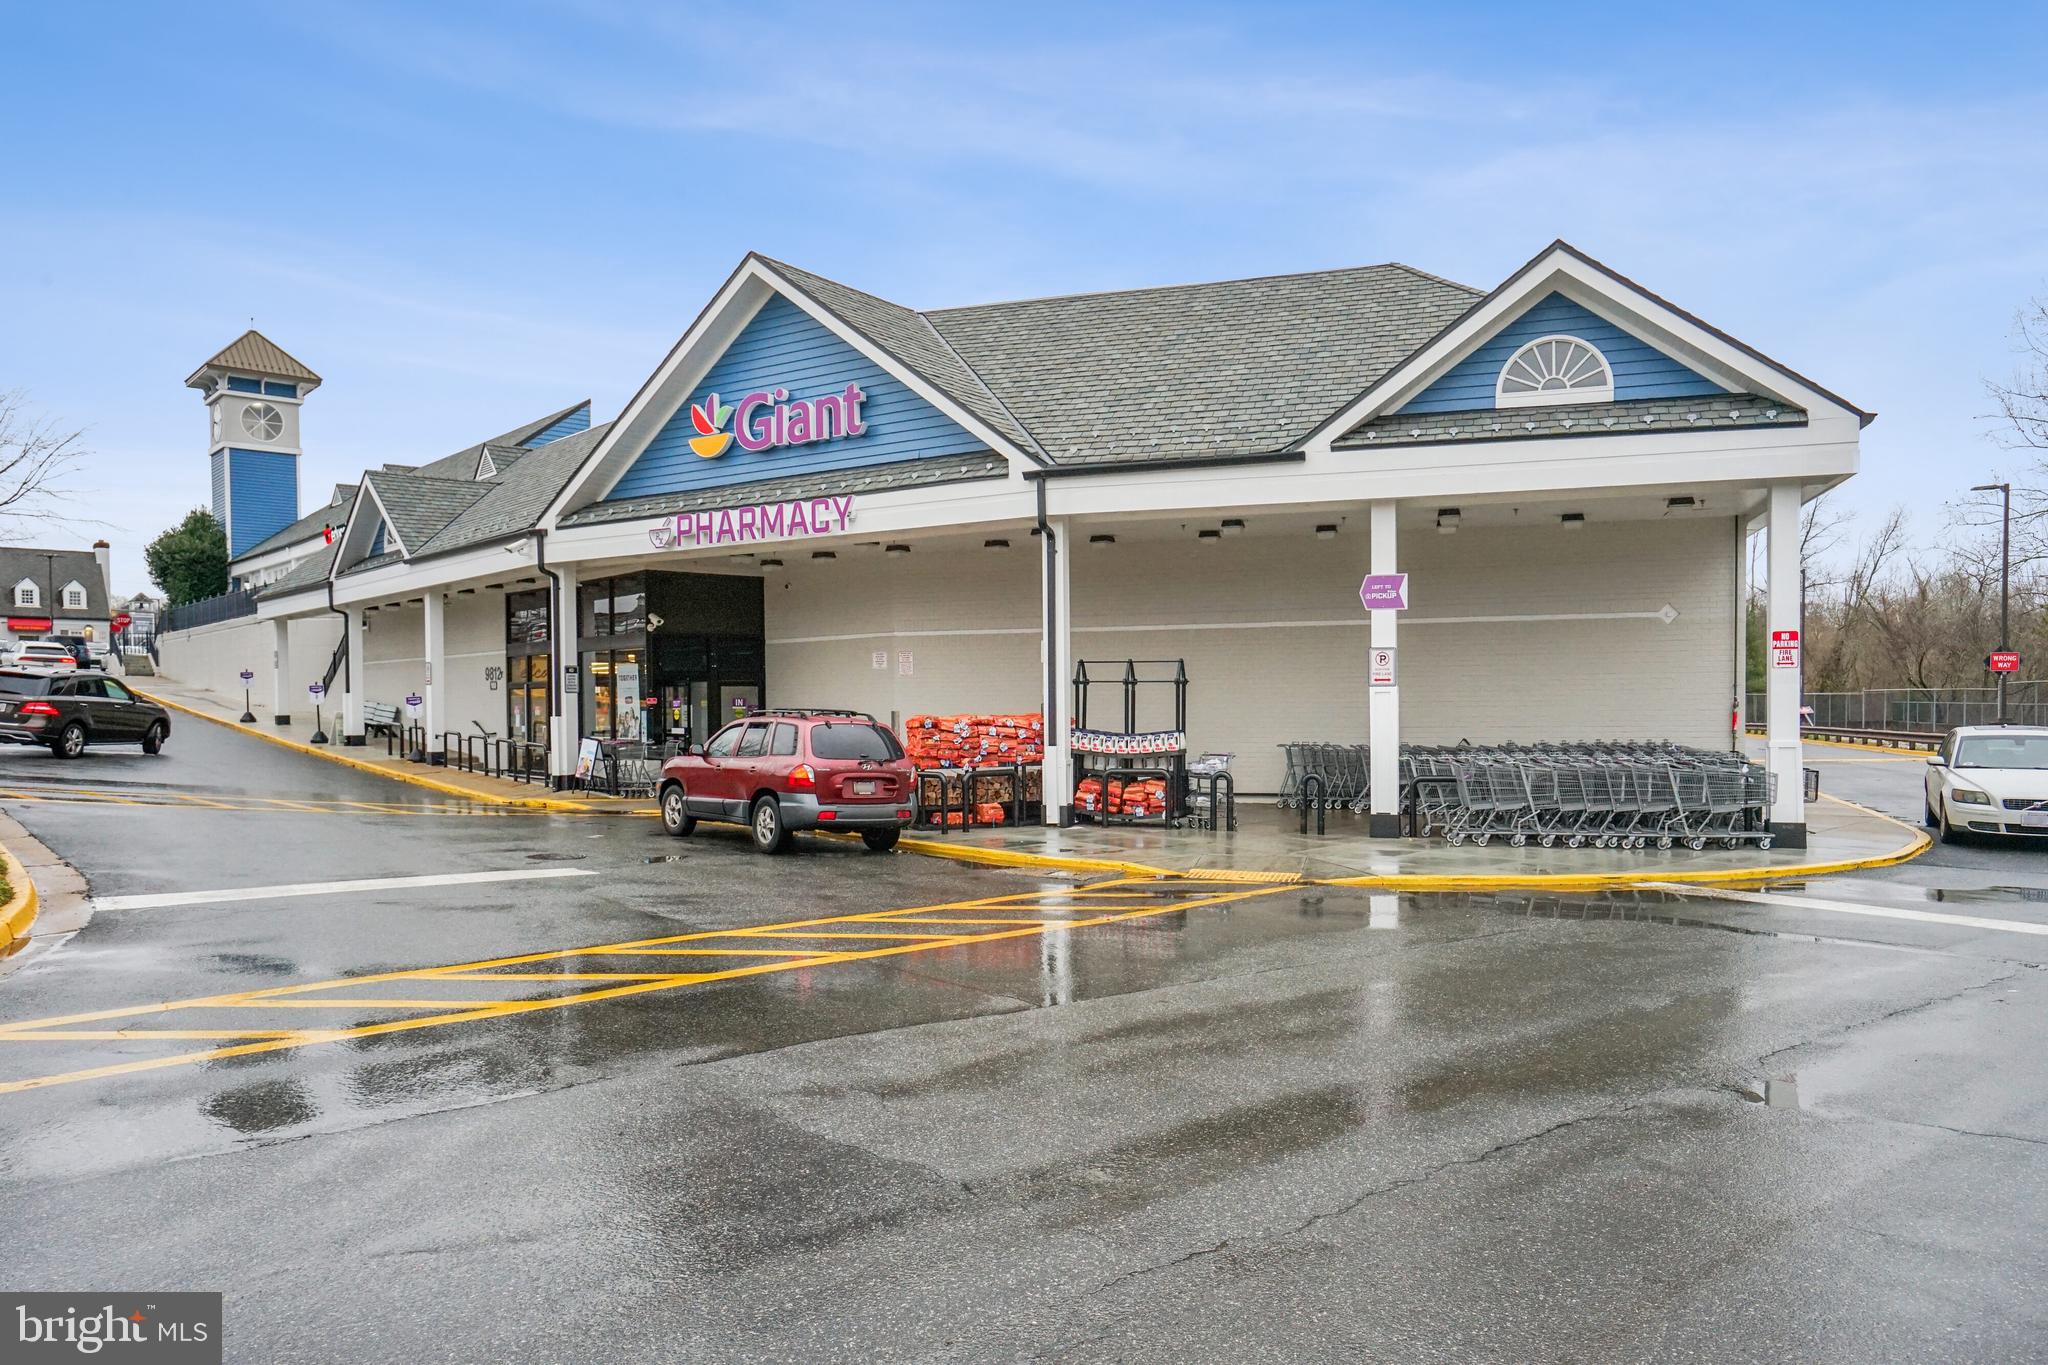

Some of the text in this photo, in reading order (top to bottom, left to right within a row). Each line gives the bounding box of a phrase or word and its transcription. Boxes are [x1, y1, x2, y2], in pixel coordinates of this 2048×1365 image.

[735, 382, 866, 452] Giant
[675, 496, 855, 546] PHARMACY
[1371, 592, 1397, 600] PICKUP
[1780, 632, 1790, 640] NO
[1772, 640, 1799, 648] PARKING
[735, 698, 744, 707] IN
